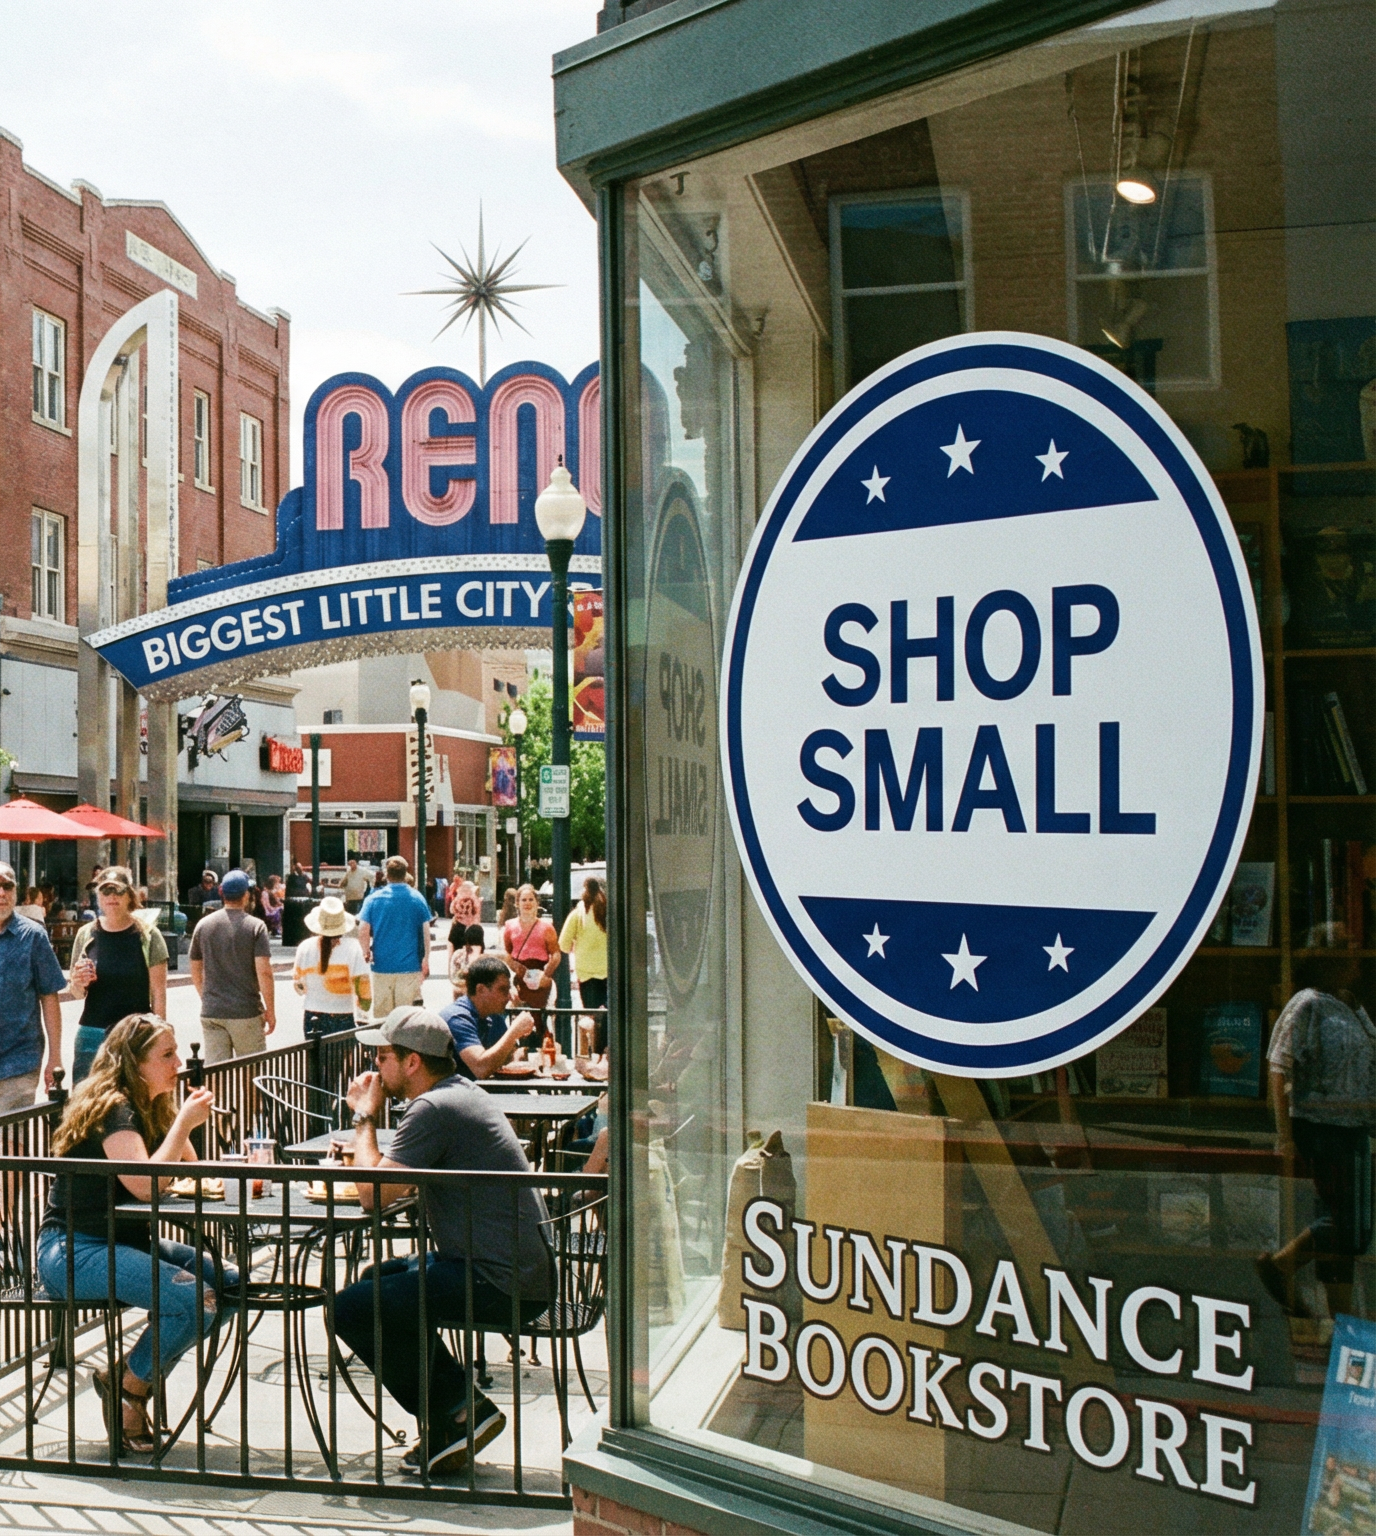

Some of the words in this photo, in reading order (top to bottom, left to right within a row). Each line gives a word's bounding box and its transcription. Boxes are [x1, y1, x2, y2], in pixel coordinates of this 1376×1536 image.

[316, 373, 601, 531] REN
[142, 600, 304, 674] BIGGEST
[319, 583, 442, 631] LITTLE
[456, 580, 551, 618] CITY
[821, 583, 1120, 708] SHOP
[796, 721, 1157, 835] SMALL
[742, 1200, 1255, 1392] SUNDANCE
[742, 1297, 1257, 1505] BOOKSTORE
